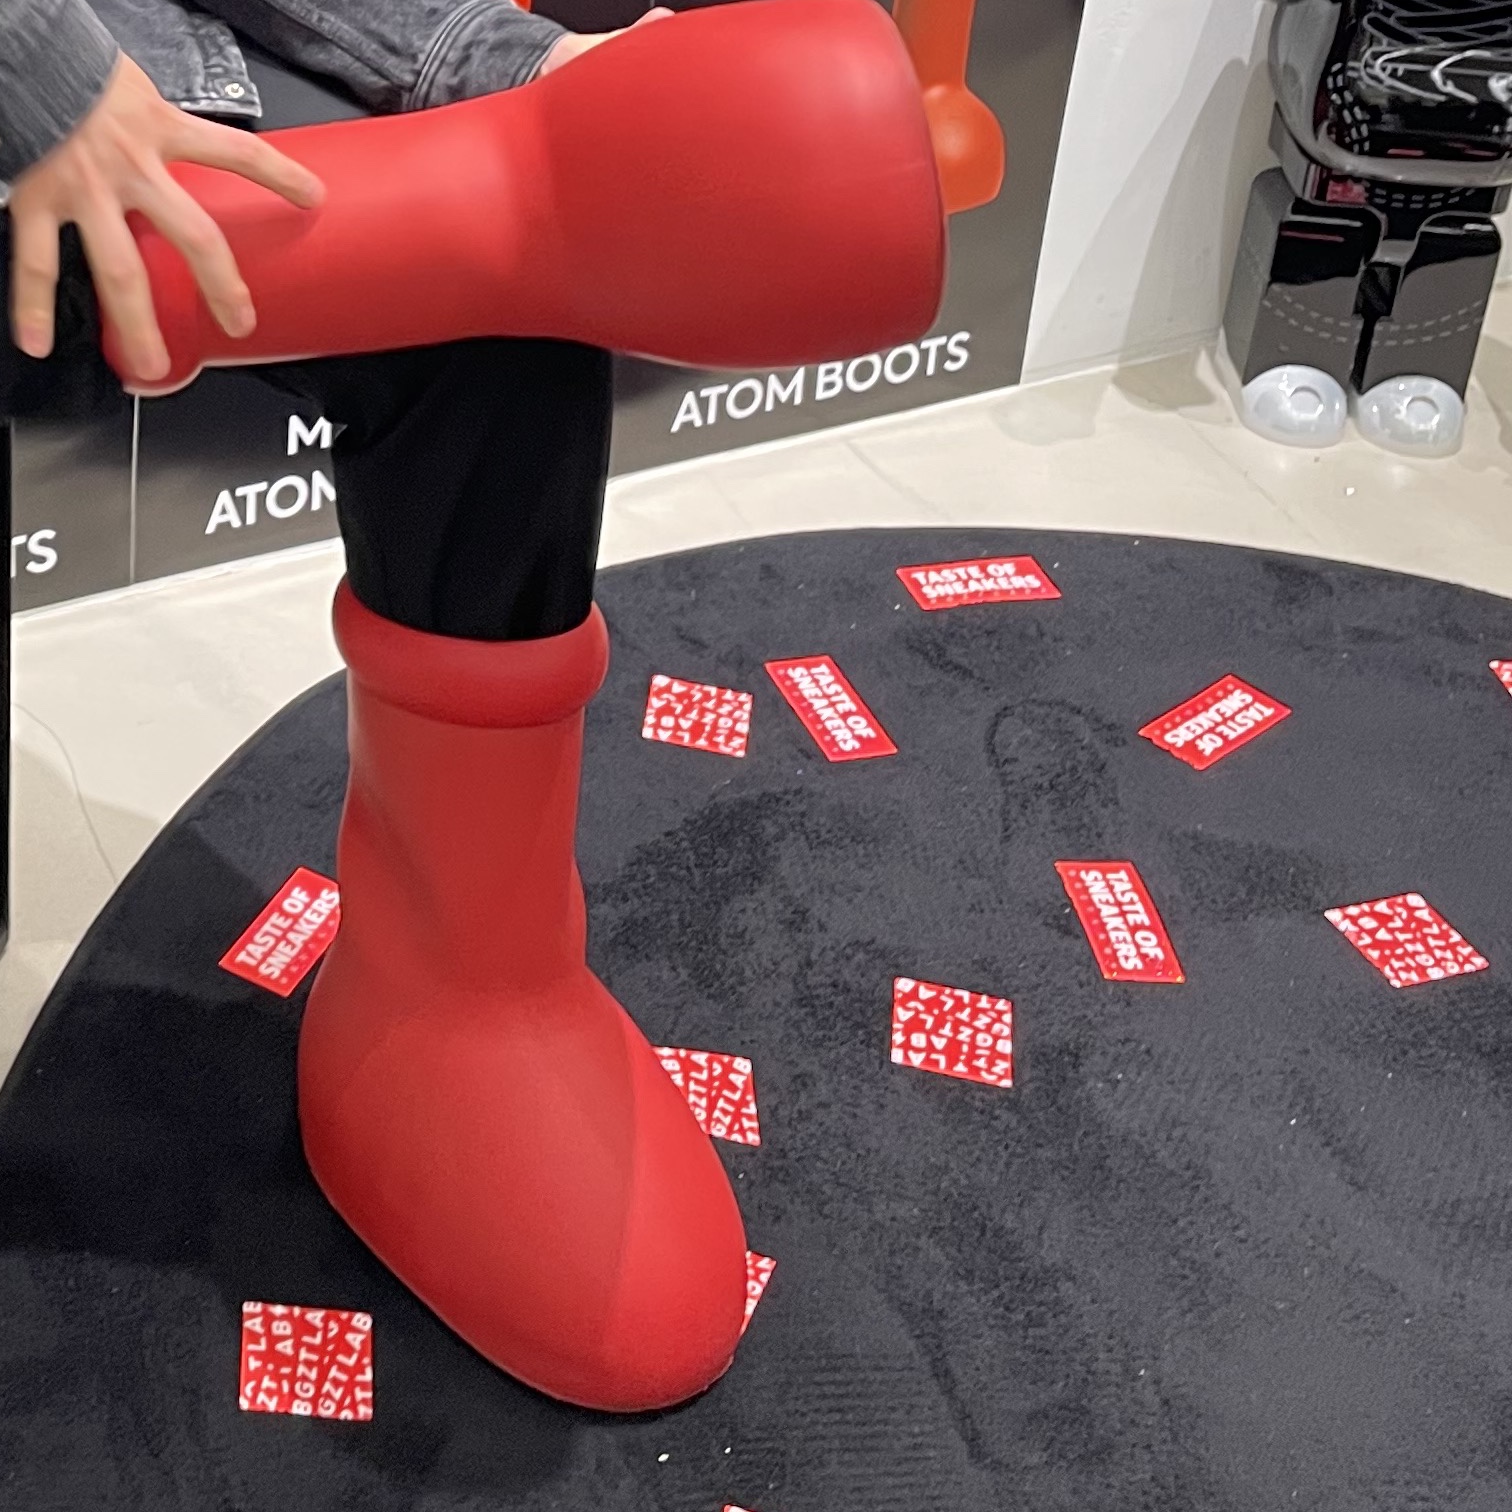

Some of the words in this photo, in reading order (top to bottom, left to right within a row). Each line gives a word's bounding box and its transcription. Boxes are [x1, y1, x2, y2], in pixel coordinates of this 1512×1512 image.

[670, 365, 806, 434] ATOM
[814, 330, 972, 401] BOOTS
[911, 565, 985, 585] TASTE
[986, 562, 1016, 577] OF
[922, 575, 1041, 598] SNEAKERS
[787, 667, 860, 751] SNEAKERS
[810, 663, 857, 714] TASTE
[846, 715, 877, 738] OF
[1164, 689, 1253, 748] SNEAKERS
[1215, 702, 1275, 740] TASTE
[1195, 733, 1223, 756] OF
[235, 912, 293, 966] TASTE
[282, 886, 310, 914] OF
[258, 889, 340, 979] SNEAKERS
[1080, 870, 1143, 970] SNEAKERS
[1106, 869, 1150, 926] TASTE
[1134, 930, 1164, 960] OF
